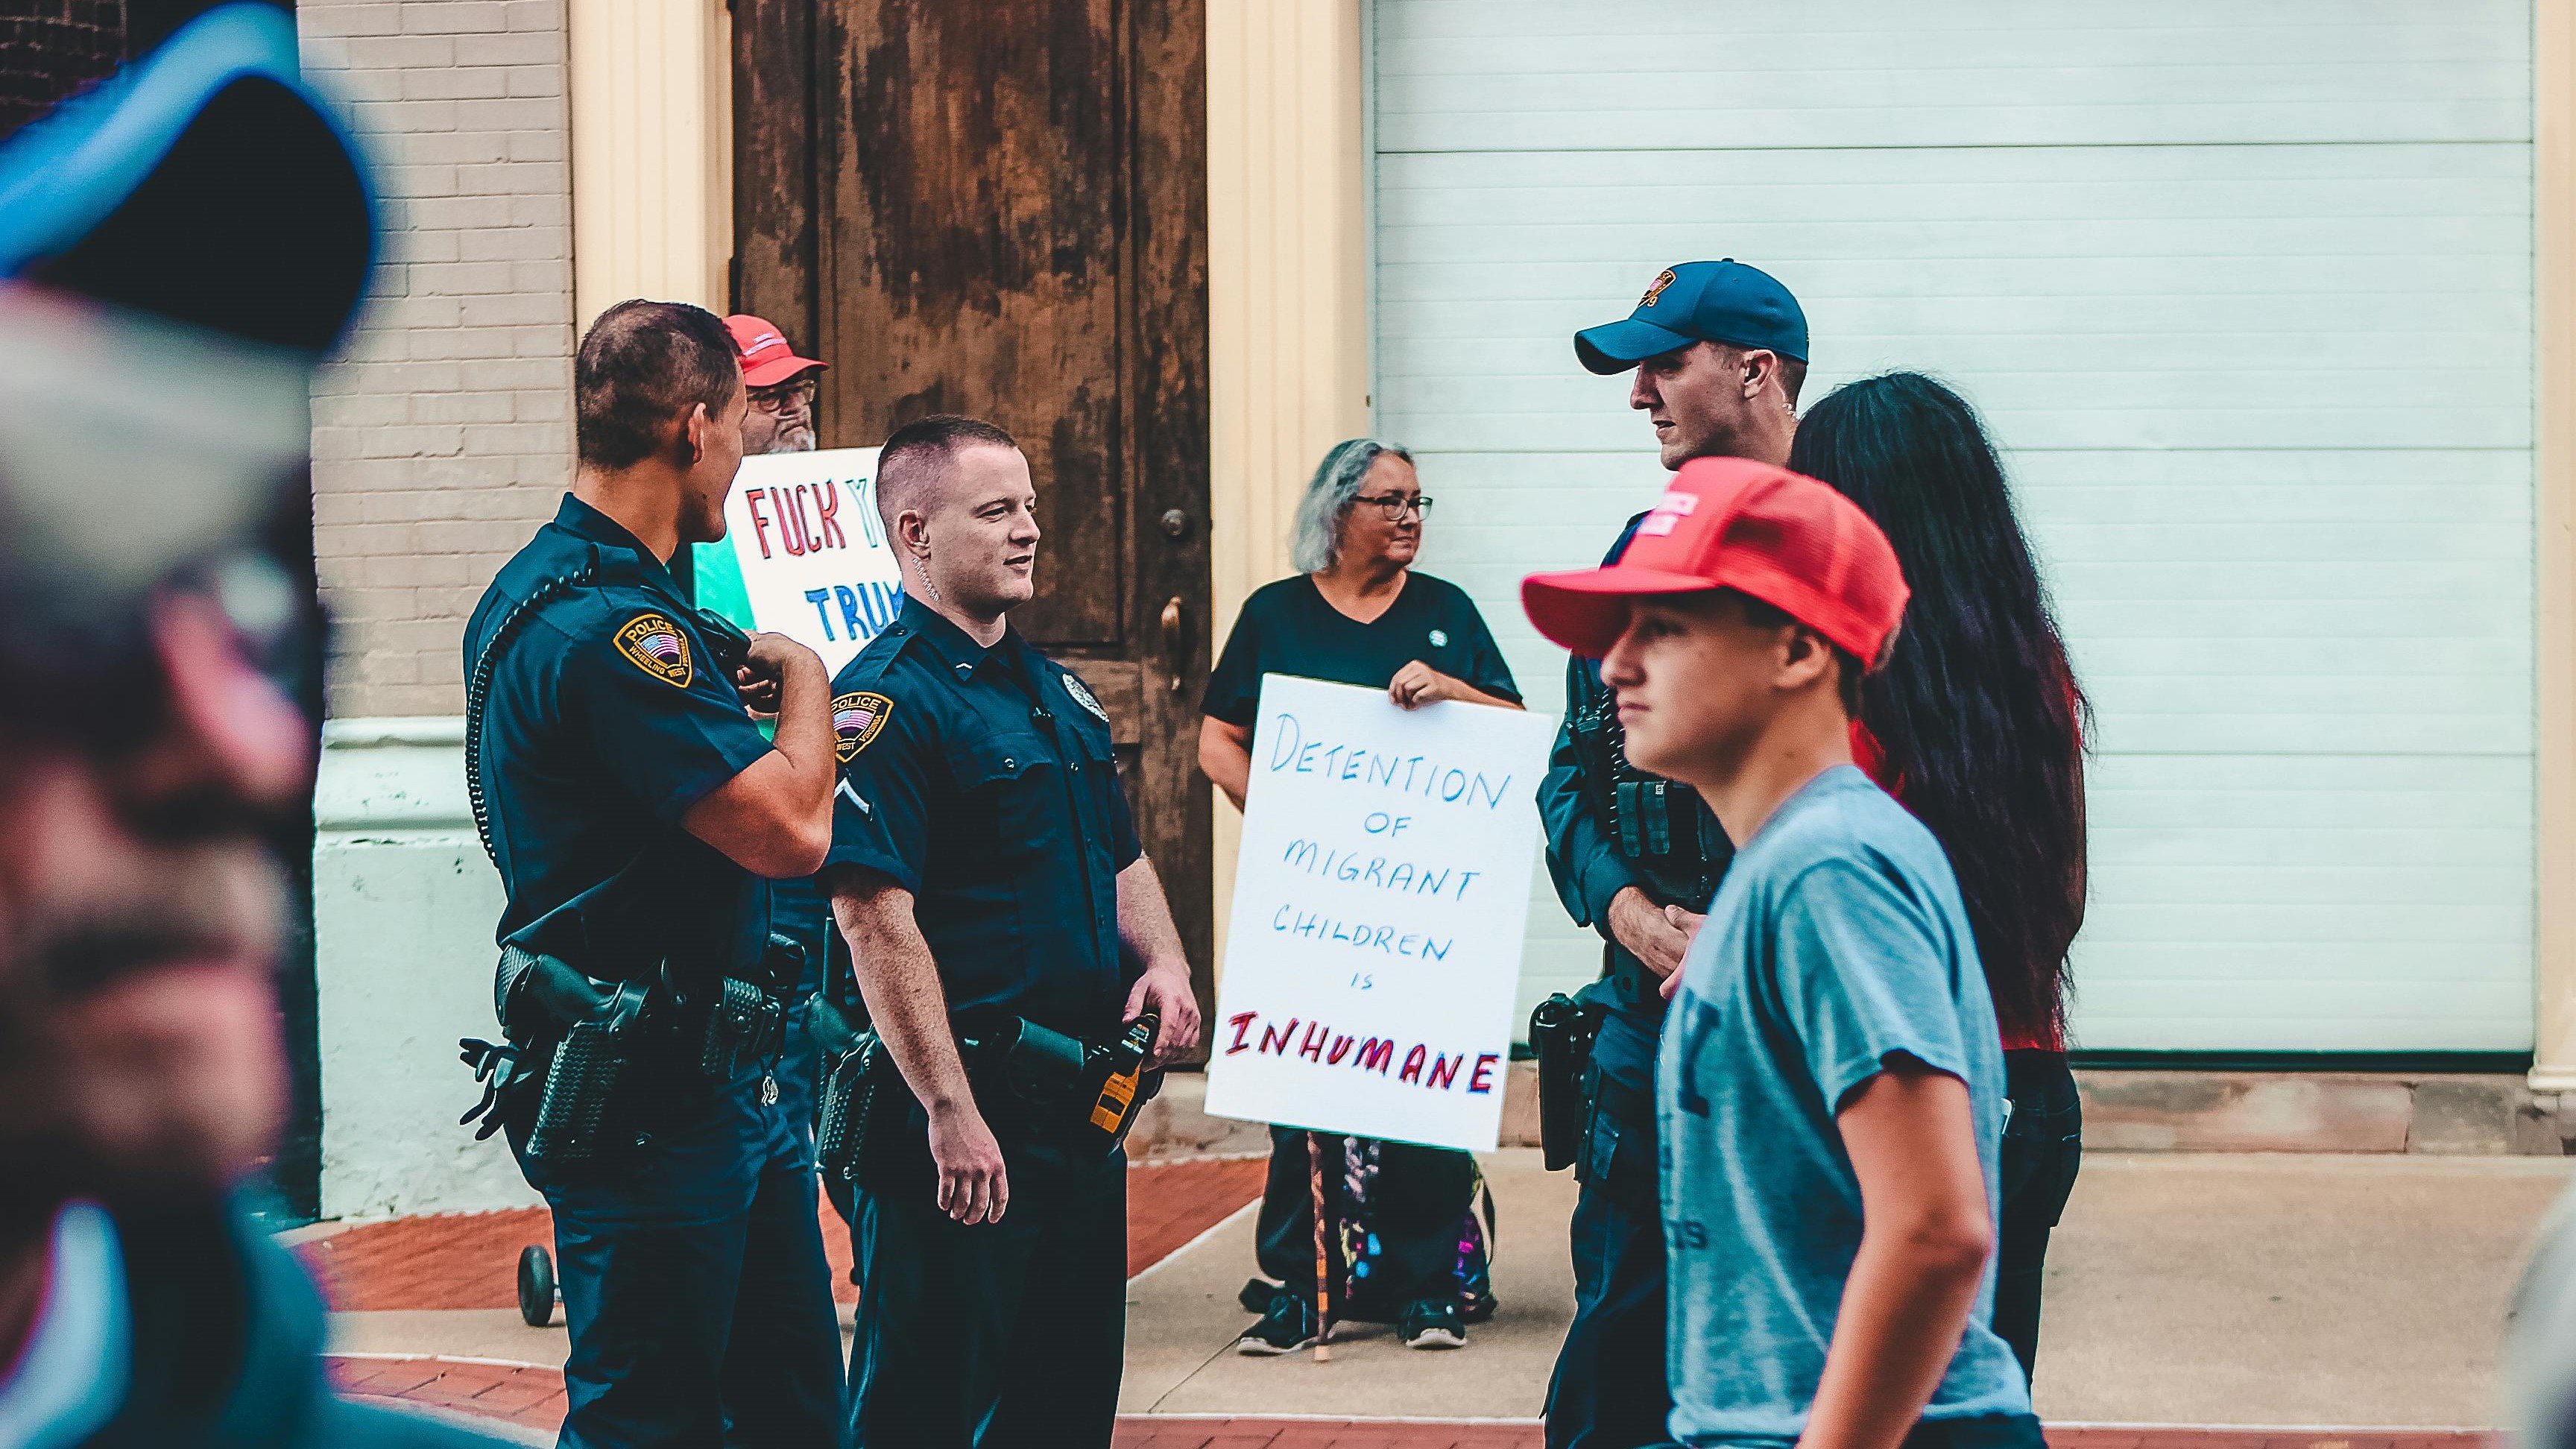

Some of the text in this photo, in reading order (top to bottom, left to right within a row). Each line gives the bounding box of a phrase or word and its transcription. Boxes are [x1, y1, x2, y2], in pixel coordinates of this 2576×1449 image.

[745, 478, 887, 560] FUCK Y
[625, 619, 675, 641] POLICE
[836, 742, 856, 751] WEST
[1270, 713, 1512, 810] DETENTION
[1364, 812, 1412, 838] OF
[1284, 839, 1480, 902] MIGRANT
[1273, 904, 1453, 962] CHILDREN
[1225, 1011, 1501, 1095] INHUMANE
